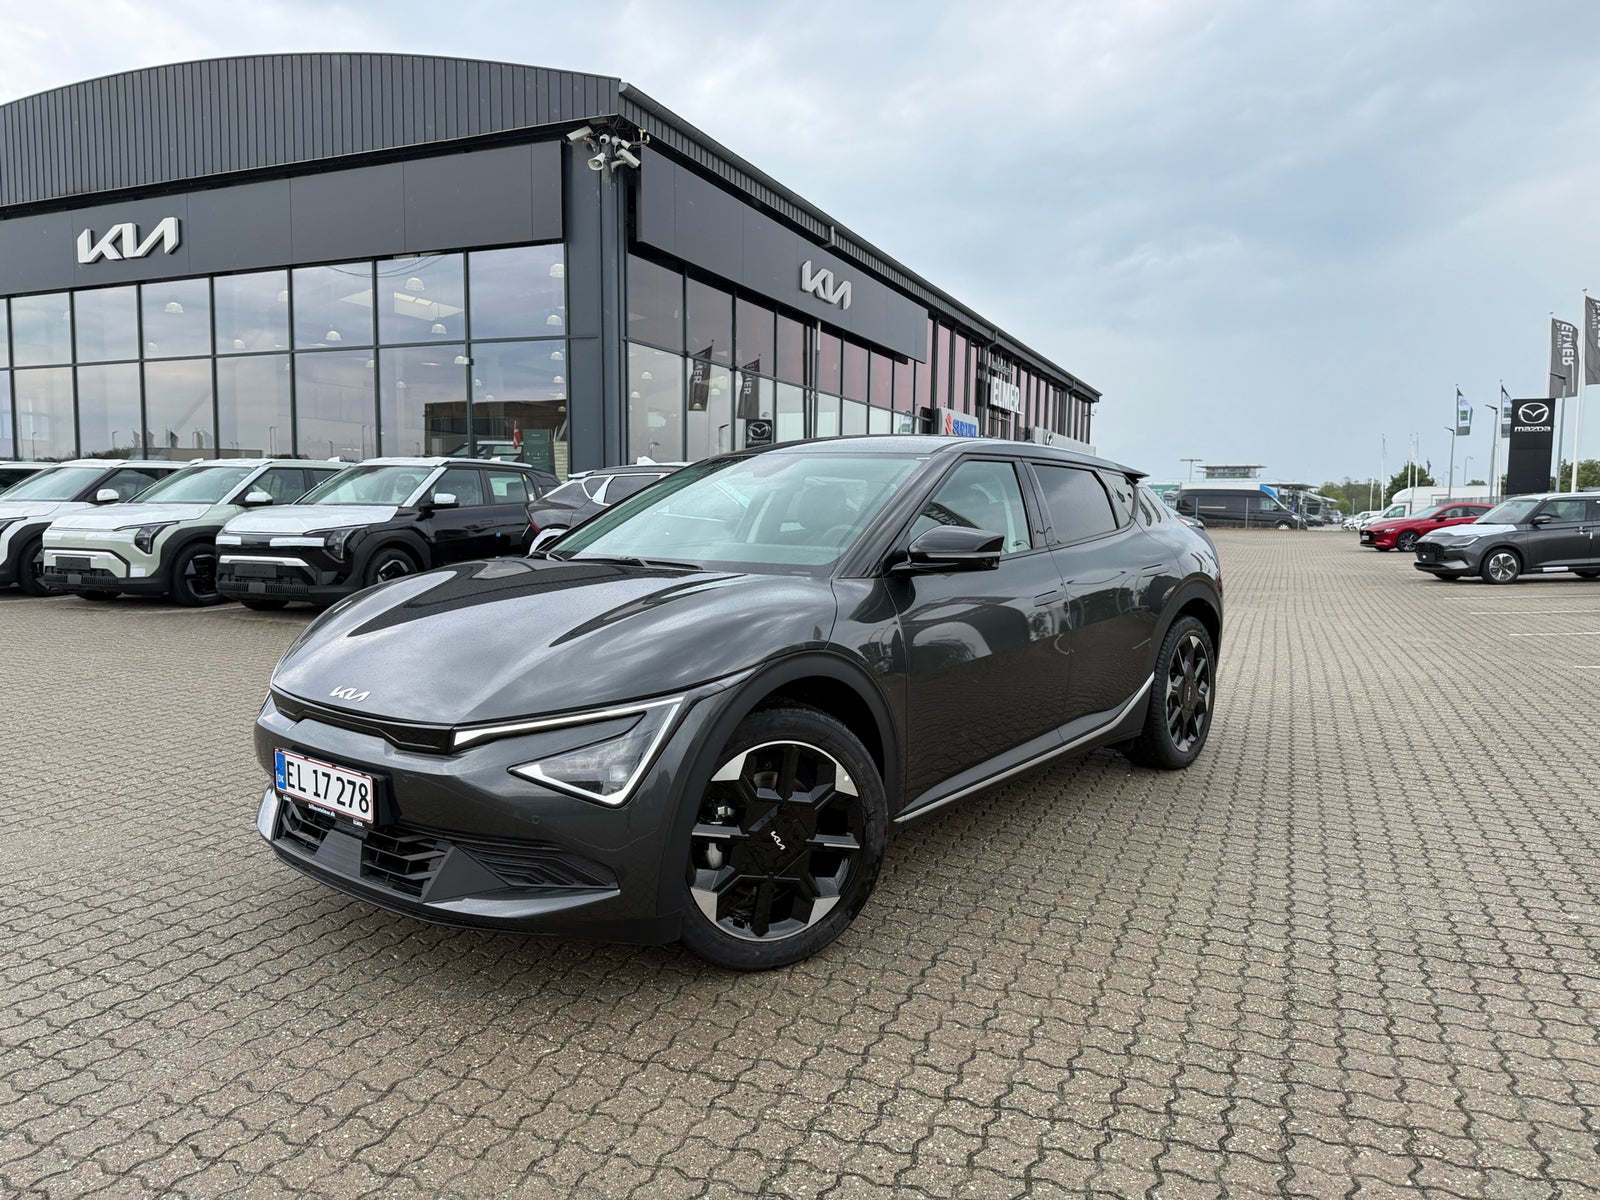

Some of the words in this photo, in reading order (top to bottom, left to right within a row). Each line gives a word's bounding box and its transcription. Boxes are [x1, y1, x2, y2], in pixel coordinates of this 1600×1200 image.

[77, 216, 180, 264] KIA
[801, 260, 852, 310] KIA
[329, 685, 371, 702] KIA
[286, 761, 307, 793] EL
[313, 769, 331, 800] 17
[336, 776, 370, 814] 278
